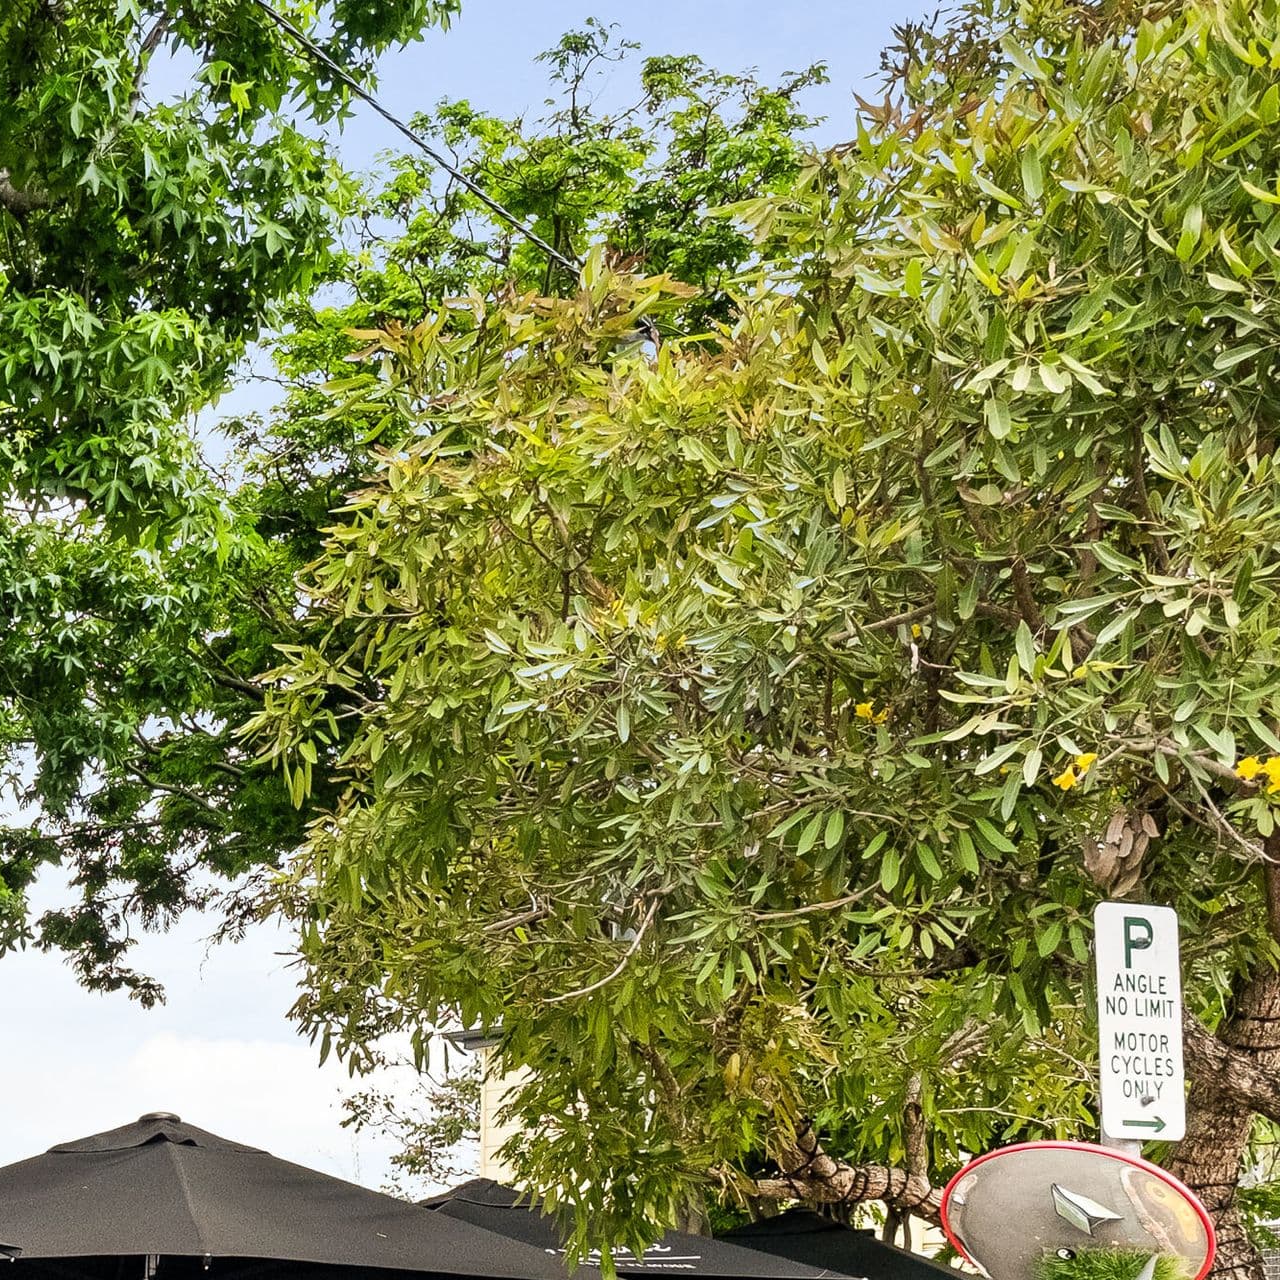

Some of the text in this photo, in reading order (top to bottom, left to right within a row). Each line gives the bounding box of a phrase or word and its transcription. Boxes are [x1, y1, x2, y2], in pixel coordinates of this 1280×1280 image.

[1123, 916, 1153, 968] P
[1113, 973, 1167, 995] ANGLE
[1106, 996, 1174, 1019] NO LIMIT
[1114, 1032, 1169, 1053] MOTOR
[1111, 1055, 1174, 1077] CYCLES
[1122, 1079, 1164, 1099] ONLY
